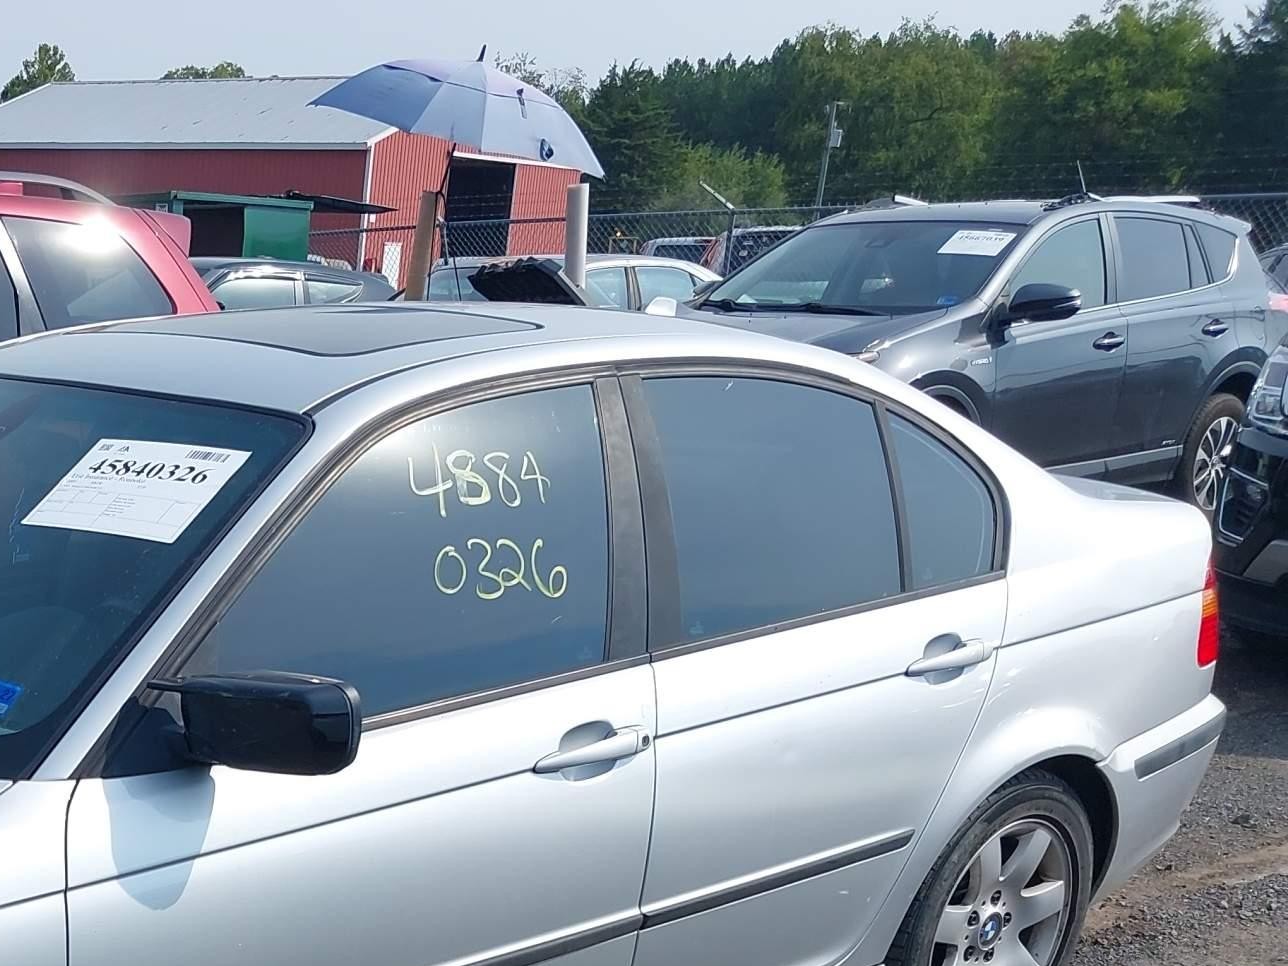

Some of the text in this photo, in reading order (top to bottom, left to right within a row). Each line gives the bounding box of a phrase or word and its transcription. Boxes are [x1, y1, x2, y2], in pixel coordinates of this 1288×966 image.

[89, 458, 215, 484] 45840326
[408, 442, 550, 517] 4884
[434, 538, 567, 600] 0326
